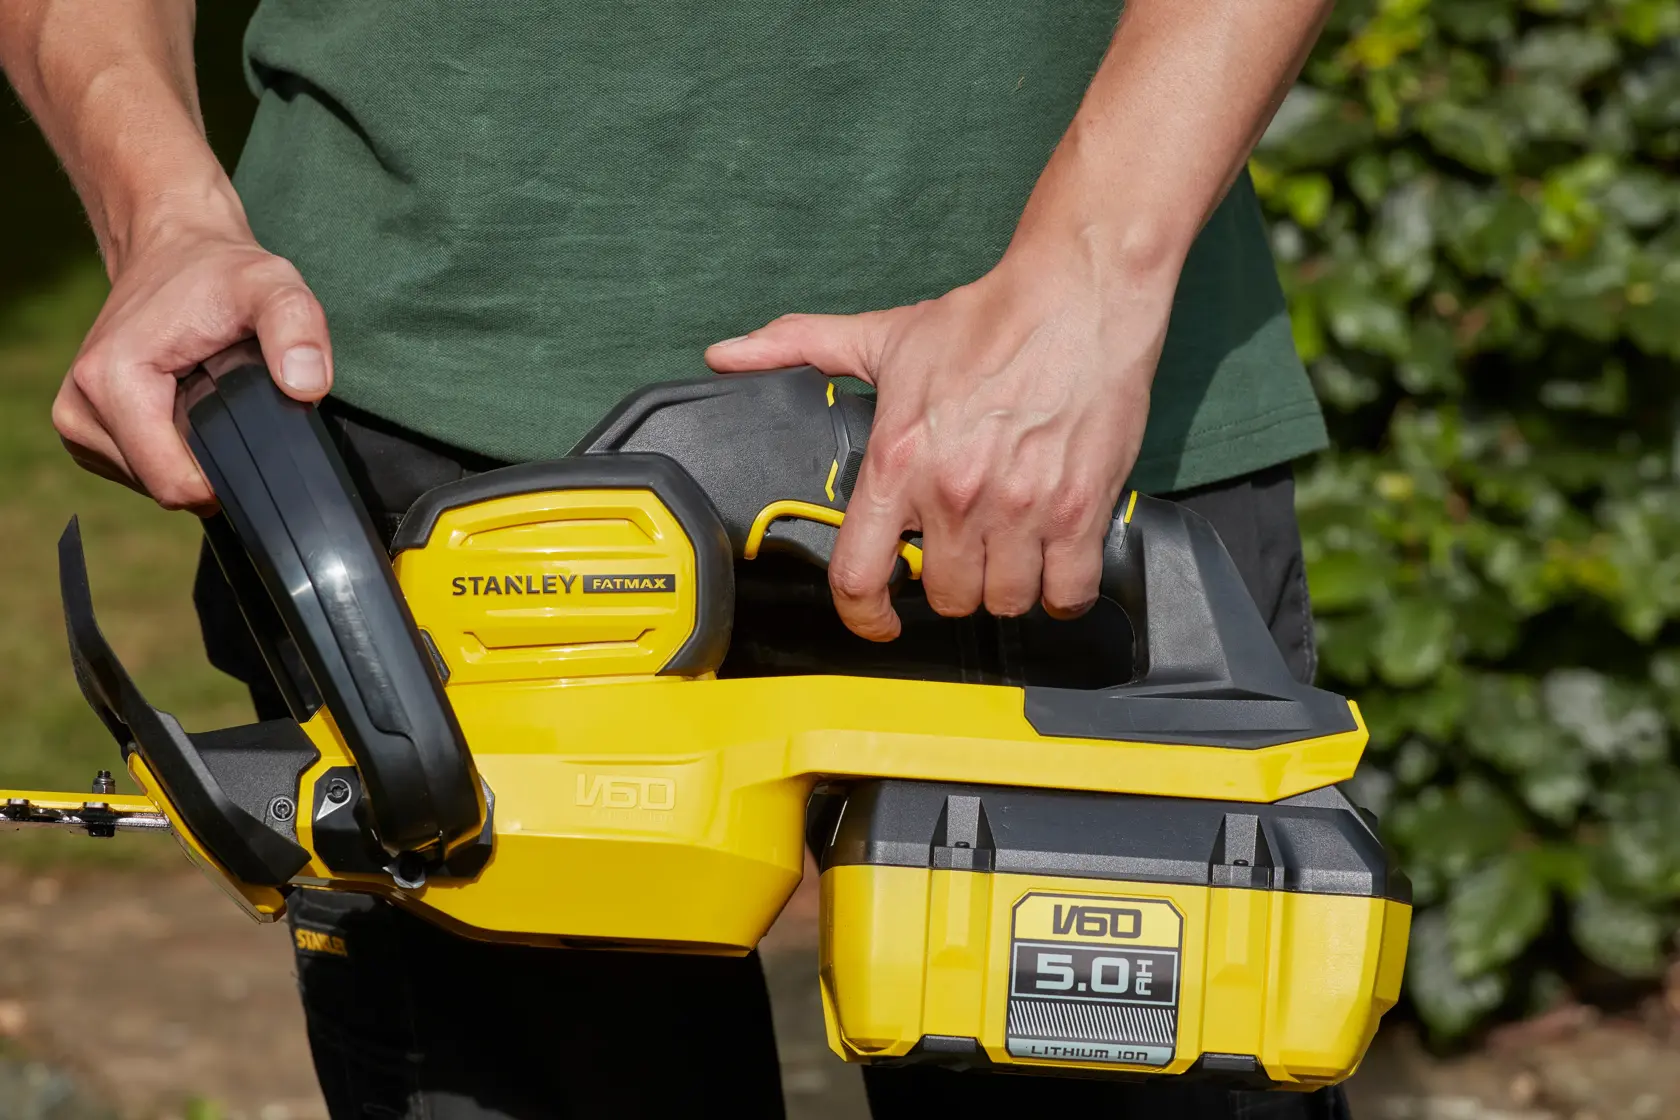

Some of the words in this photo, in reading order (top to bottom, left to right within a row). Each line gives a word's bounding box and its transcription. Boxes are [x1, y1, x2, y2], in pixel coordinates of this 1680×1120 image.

[452, 574, 578, 596] STANLEY
[592, 578, 667, 590] FATMAX
[575, 773, 676, 811] V60
[1052, 904, 1142, 938] V60
[1035, 953, 1130, 994] 5.0
[1135, 959, 1153, 996] AH
[1030, 1045, 1109, 1059] LITHIUM
[1117, 1050, 1148, 1061] ION
